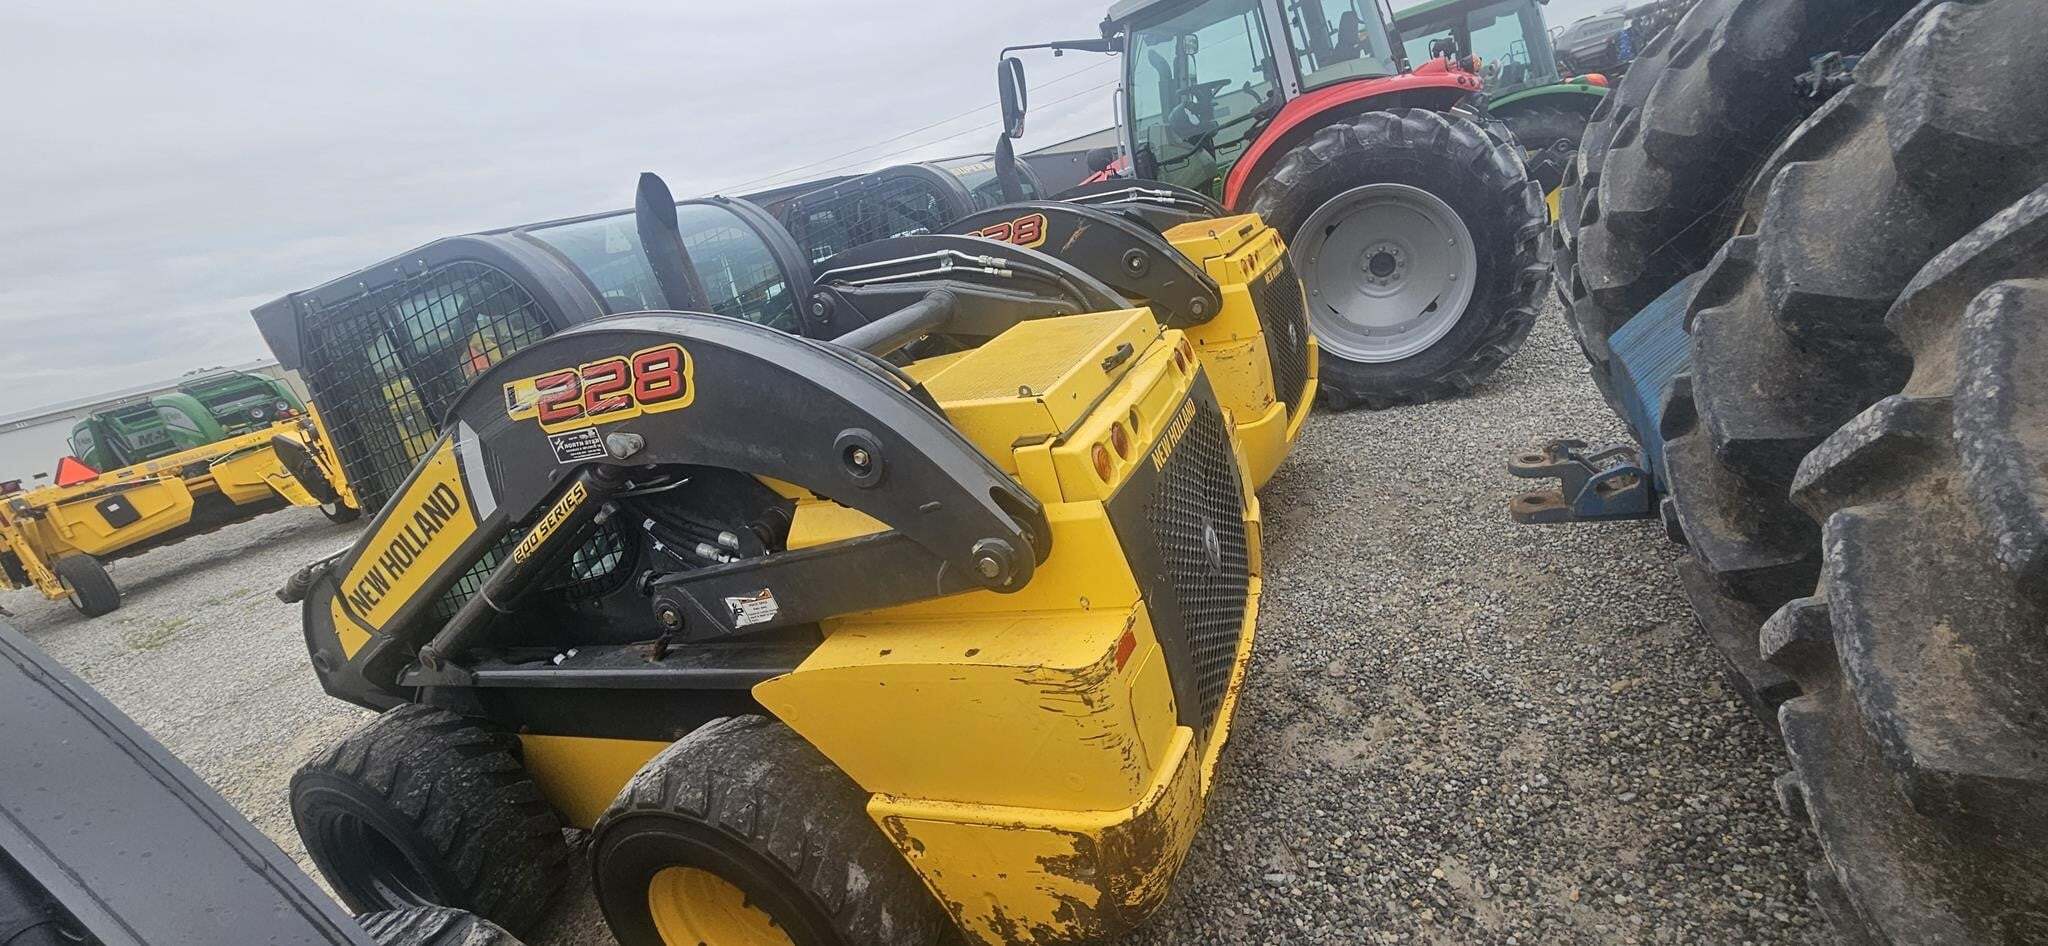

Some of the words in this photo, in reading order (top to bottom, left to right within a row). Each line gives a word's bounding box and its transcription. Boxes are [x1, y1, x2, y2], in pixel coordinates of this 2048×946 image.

[1152, 434, 1172, 472] NEW
[1168, 397, 1196, 448] HOLLAND
[348, 564, 391, 617] NEW
[378, 482, 460, 581] HOLLAND
[514, 532, 539, 562] 200
[540, 484, 584, 537] SERIES
